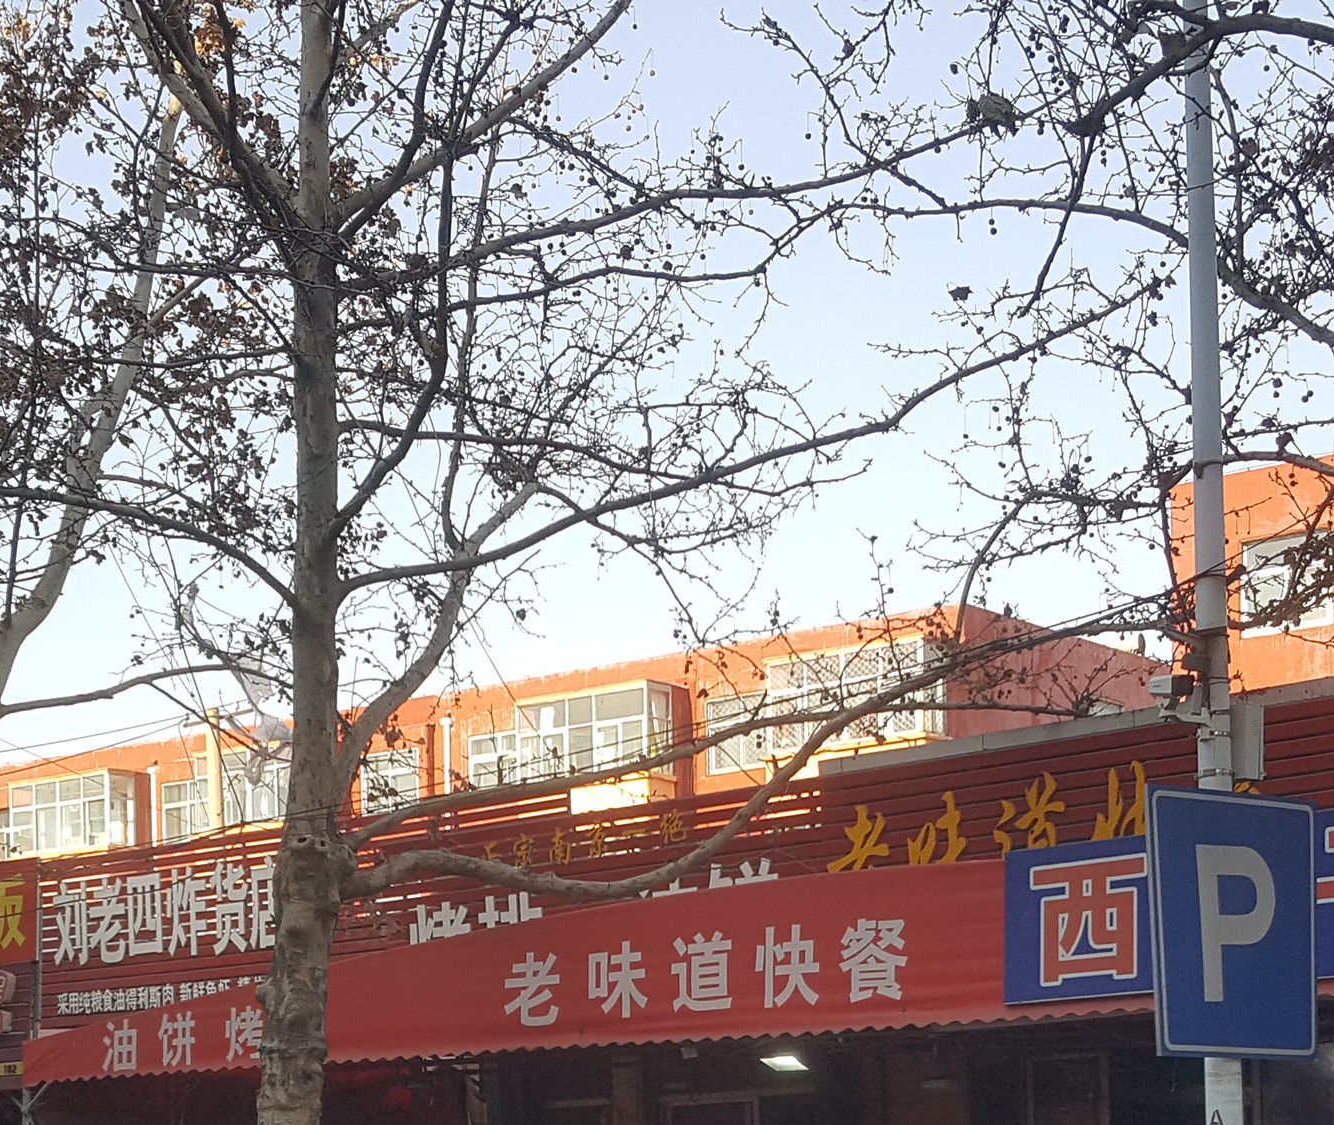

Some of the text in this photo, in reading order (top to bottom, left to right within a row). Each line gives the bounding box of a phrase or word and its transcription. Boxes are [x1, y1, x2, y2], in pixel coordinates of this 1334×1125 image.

[503, 918, 908, 1028] 老味道快餐
[1196, 844, 1276, 1003] P
